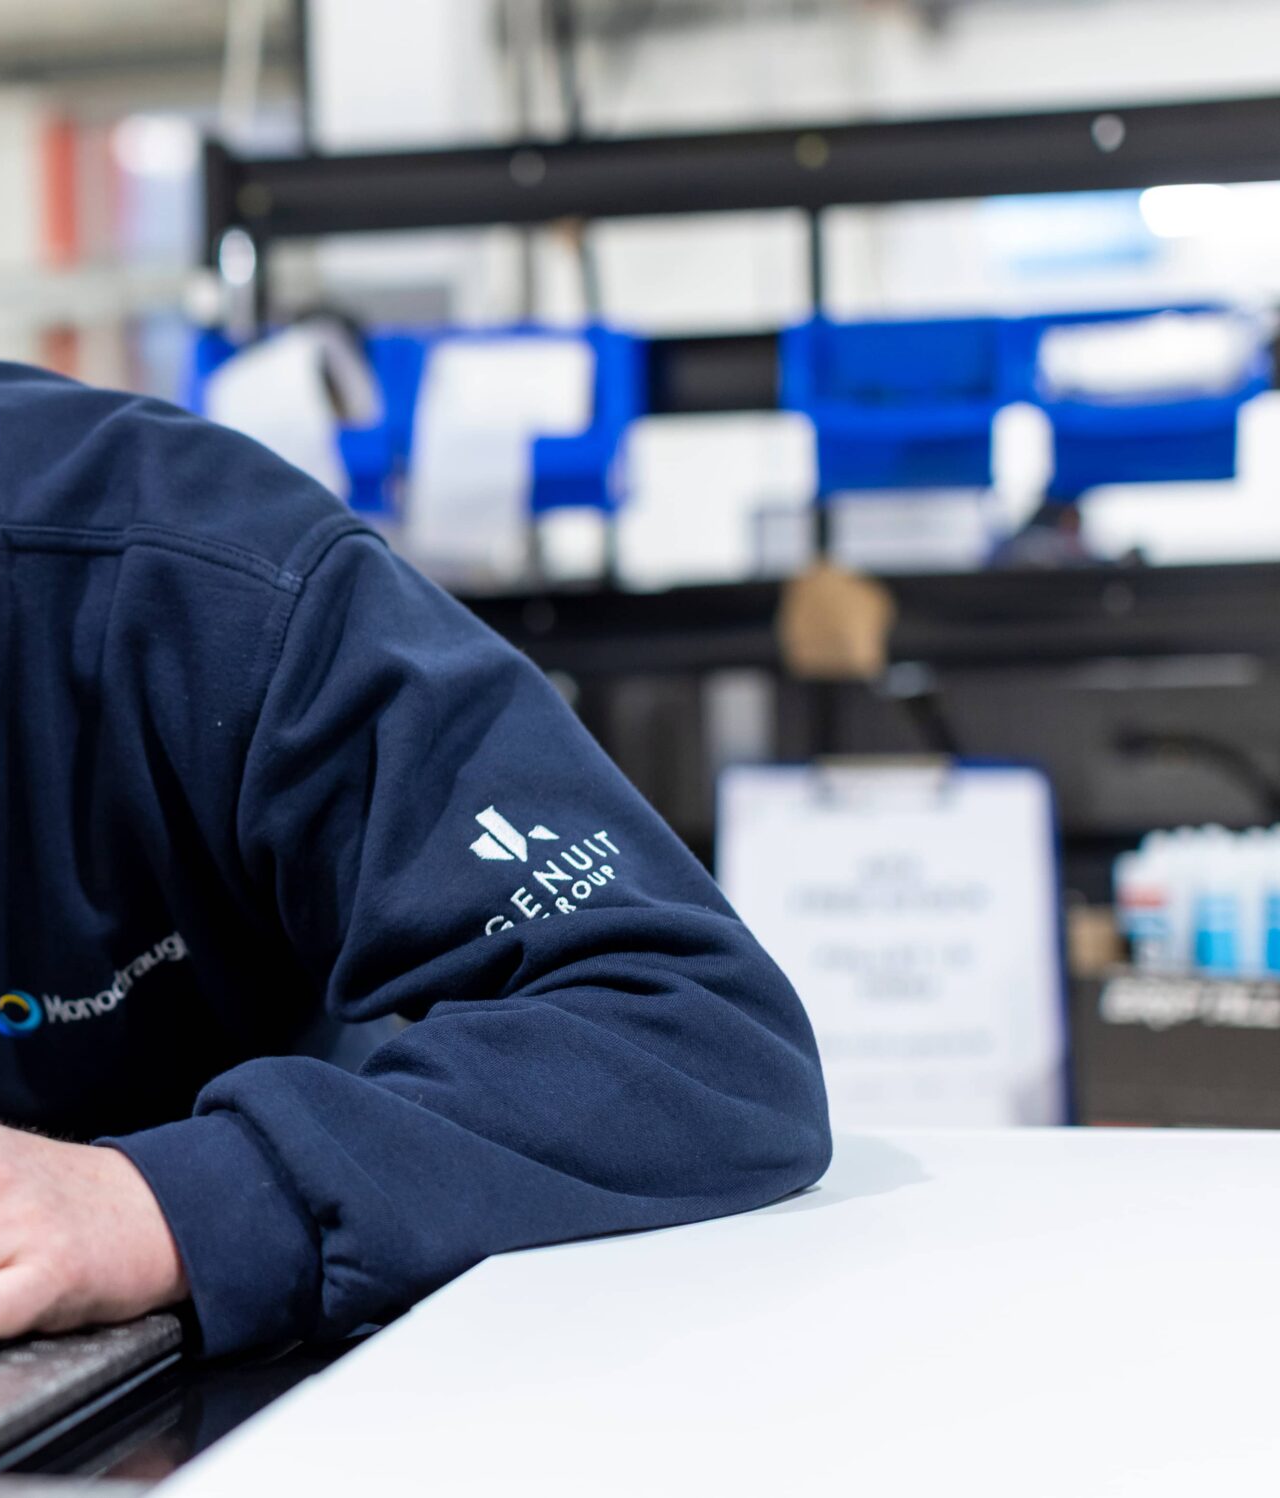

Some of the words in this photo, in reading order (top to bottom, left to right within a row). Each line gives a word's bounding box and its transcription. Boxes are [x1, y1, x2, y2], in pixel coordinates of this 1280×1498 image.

[485, 830, 620, 936] GENUIT
[542, 864, 616, 919] ROUP
[42, 931, 187, 1023] Monodraug
